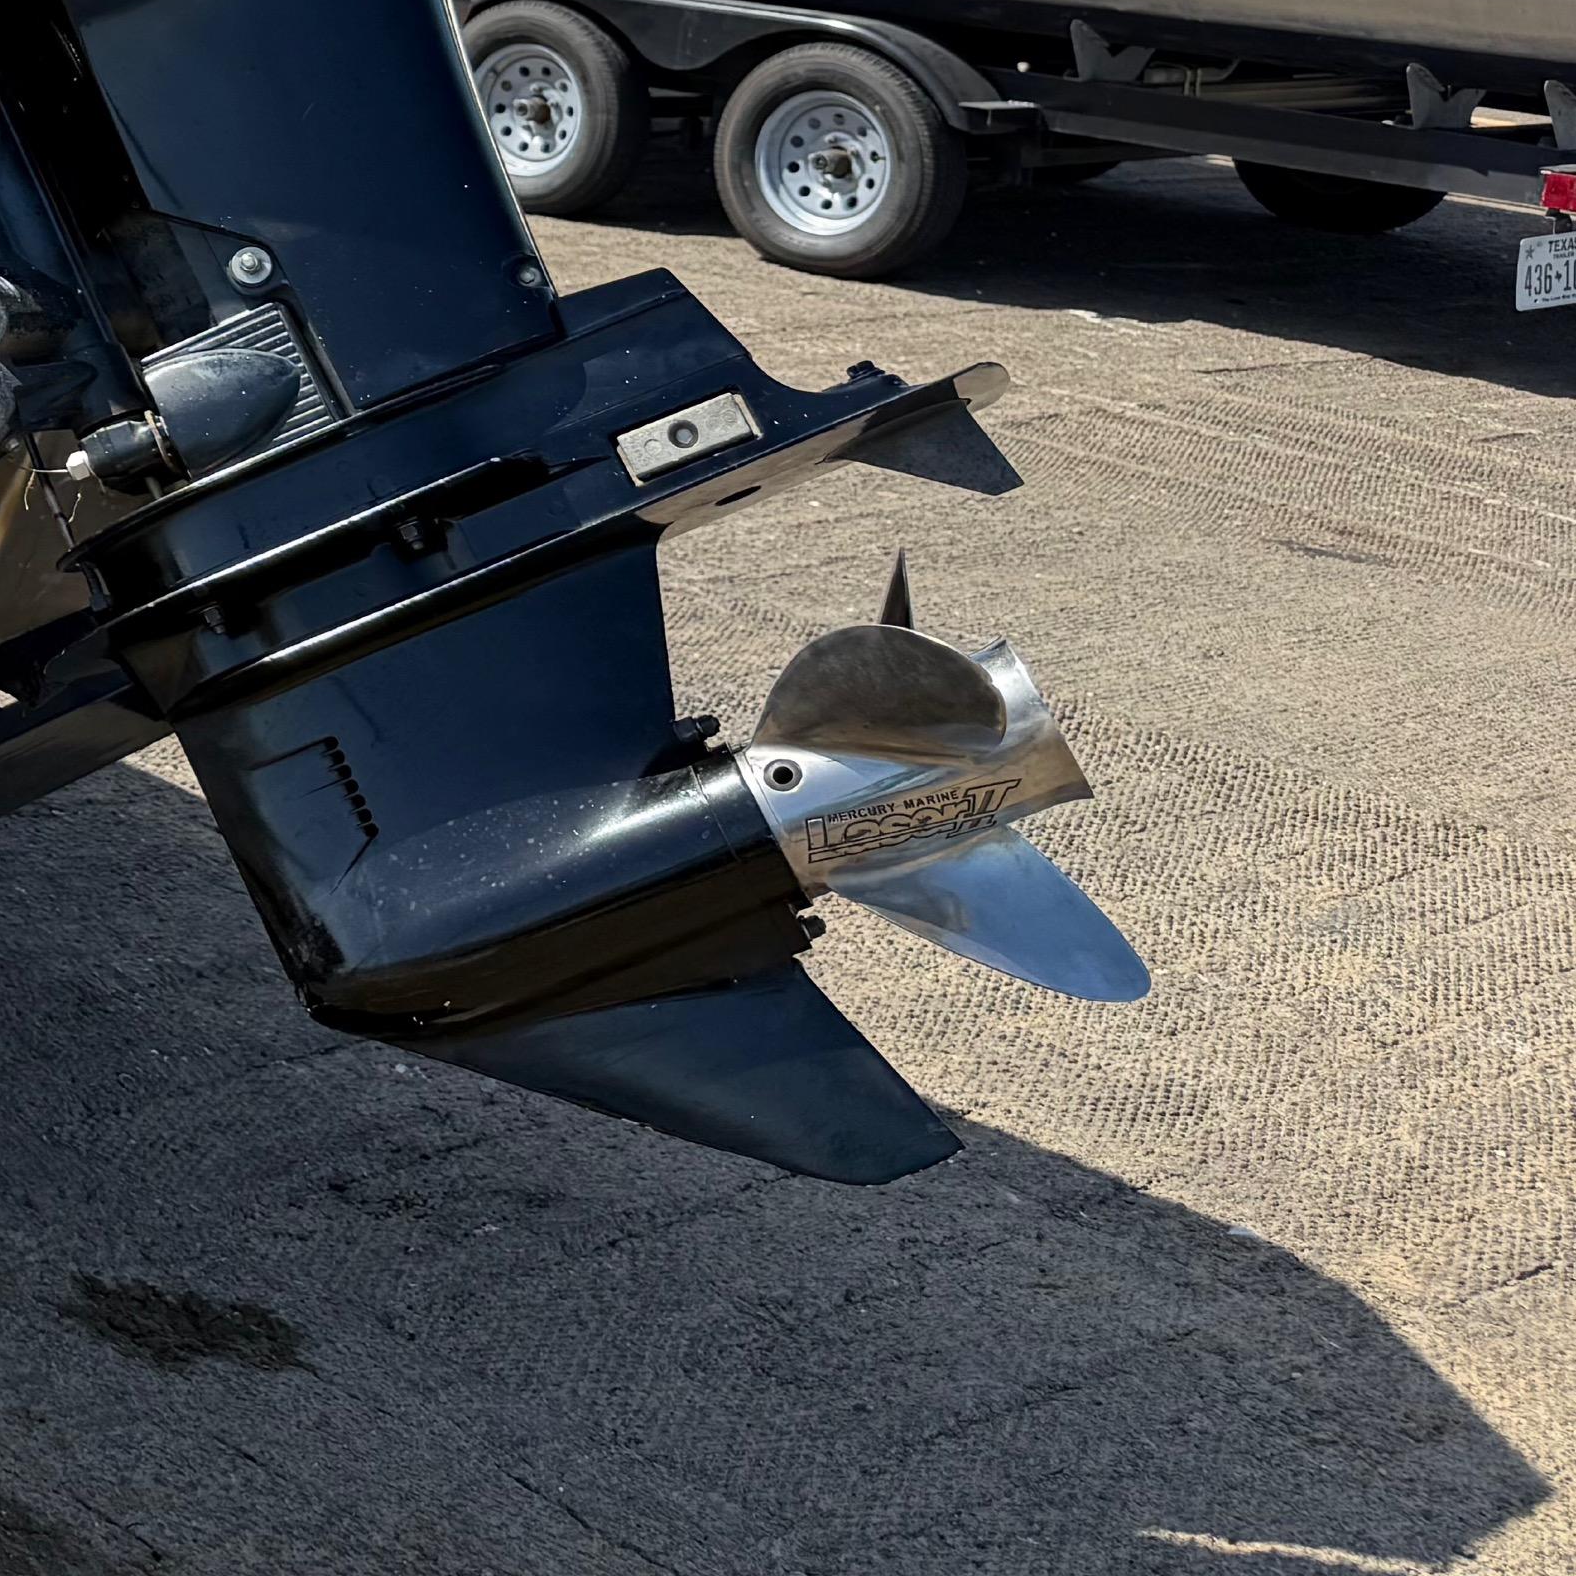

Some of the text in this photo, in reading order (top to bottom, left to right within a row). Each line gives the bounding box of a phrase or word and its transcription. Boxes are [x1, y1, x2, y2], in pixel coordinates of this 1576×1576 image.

[1548, 236, 1576, 253] TEXA
[828, 789, 960, 823] MERCURY MARINE
